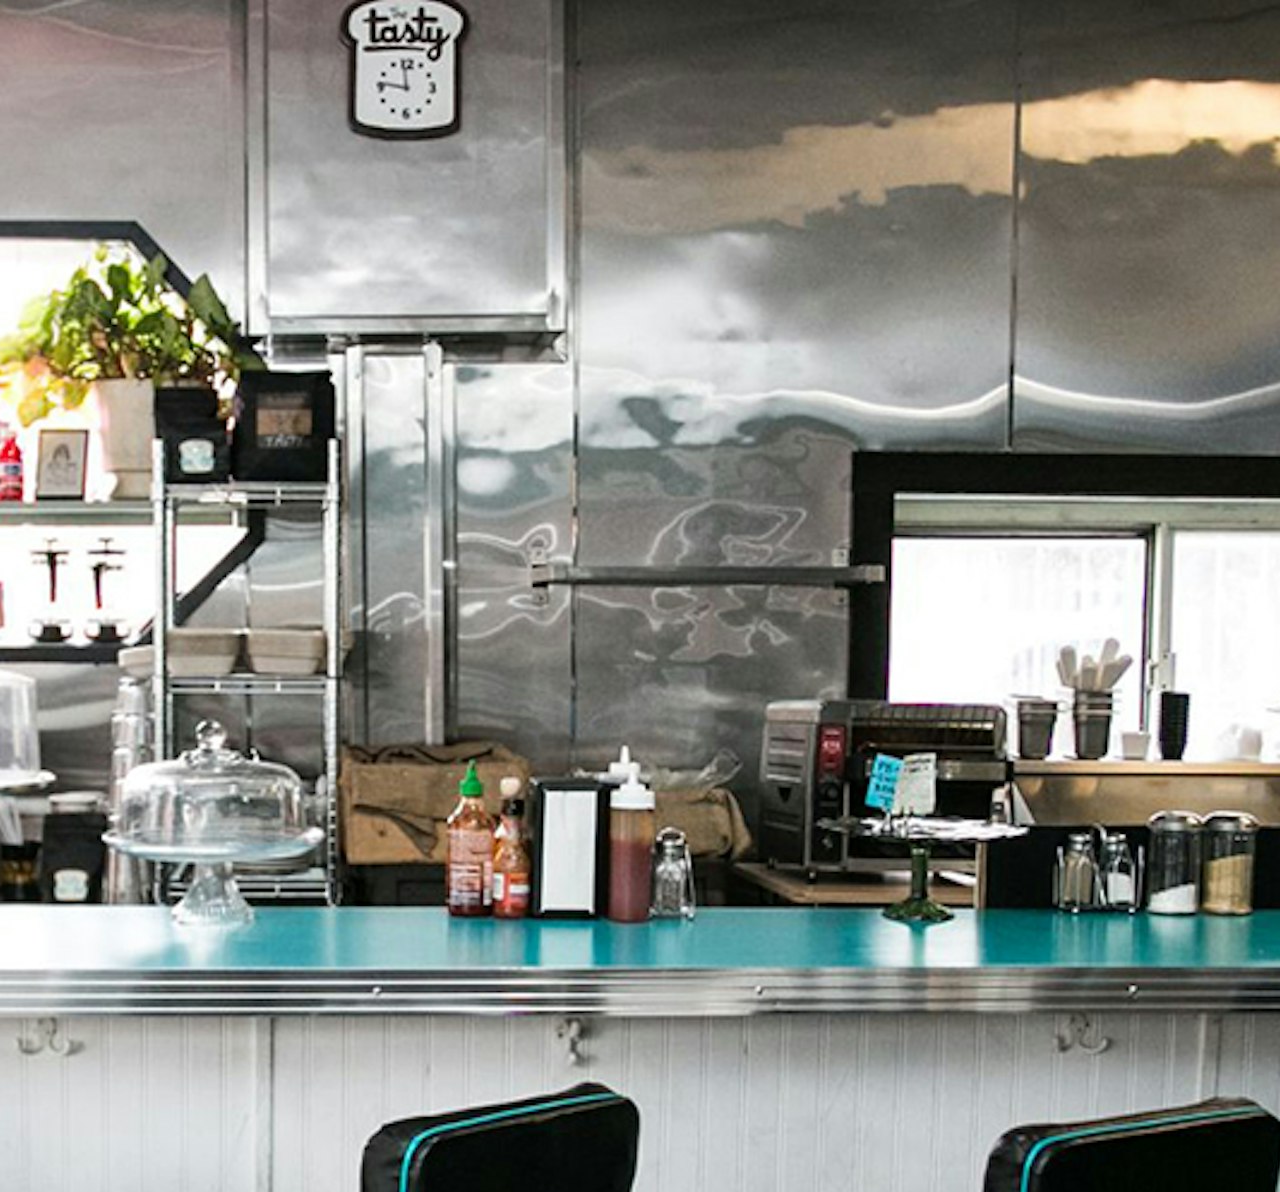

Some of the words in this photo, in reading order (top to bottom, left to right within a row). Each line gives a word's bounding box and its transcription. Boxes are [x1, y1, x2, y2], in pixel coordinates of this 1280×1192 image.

[363, 7, 450, 61] tasty
[400, 59, 414, 70] 12
[429, 82, 437, 94] 3
[402, 108, 410, 119] 6
